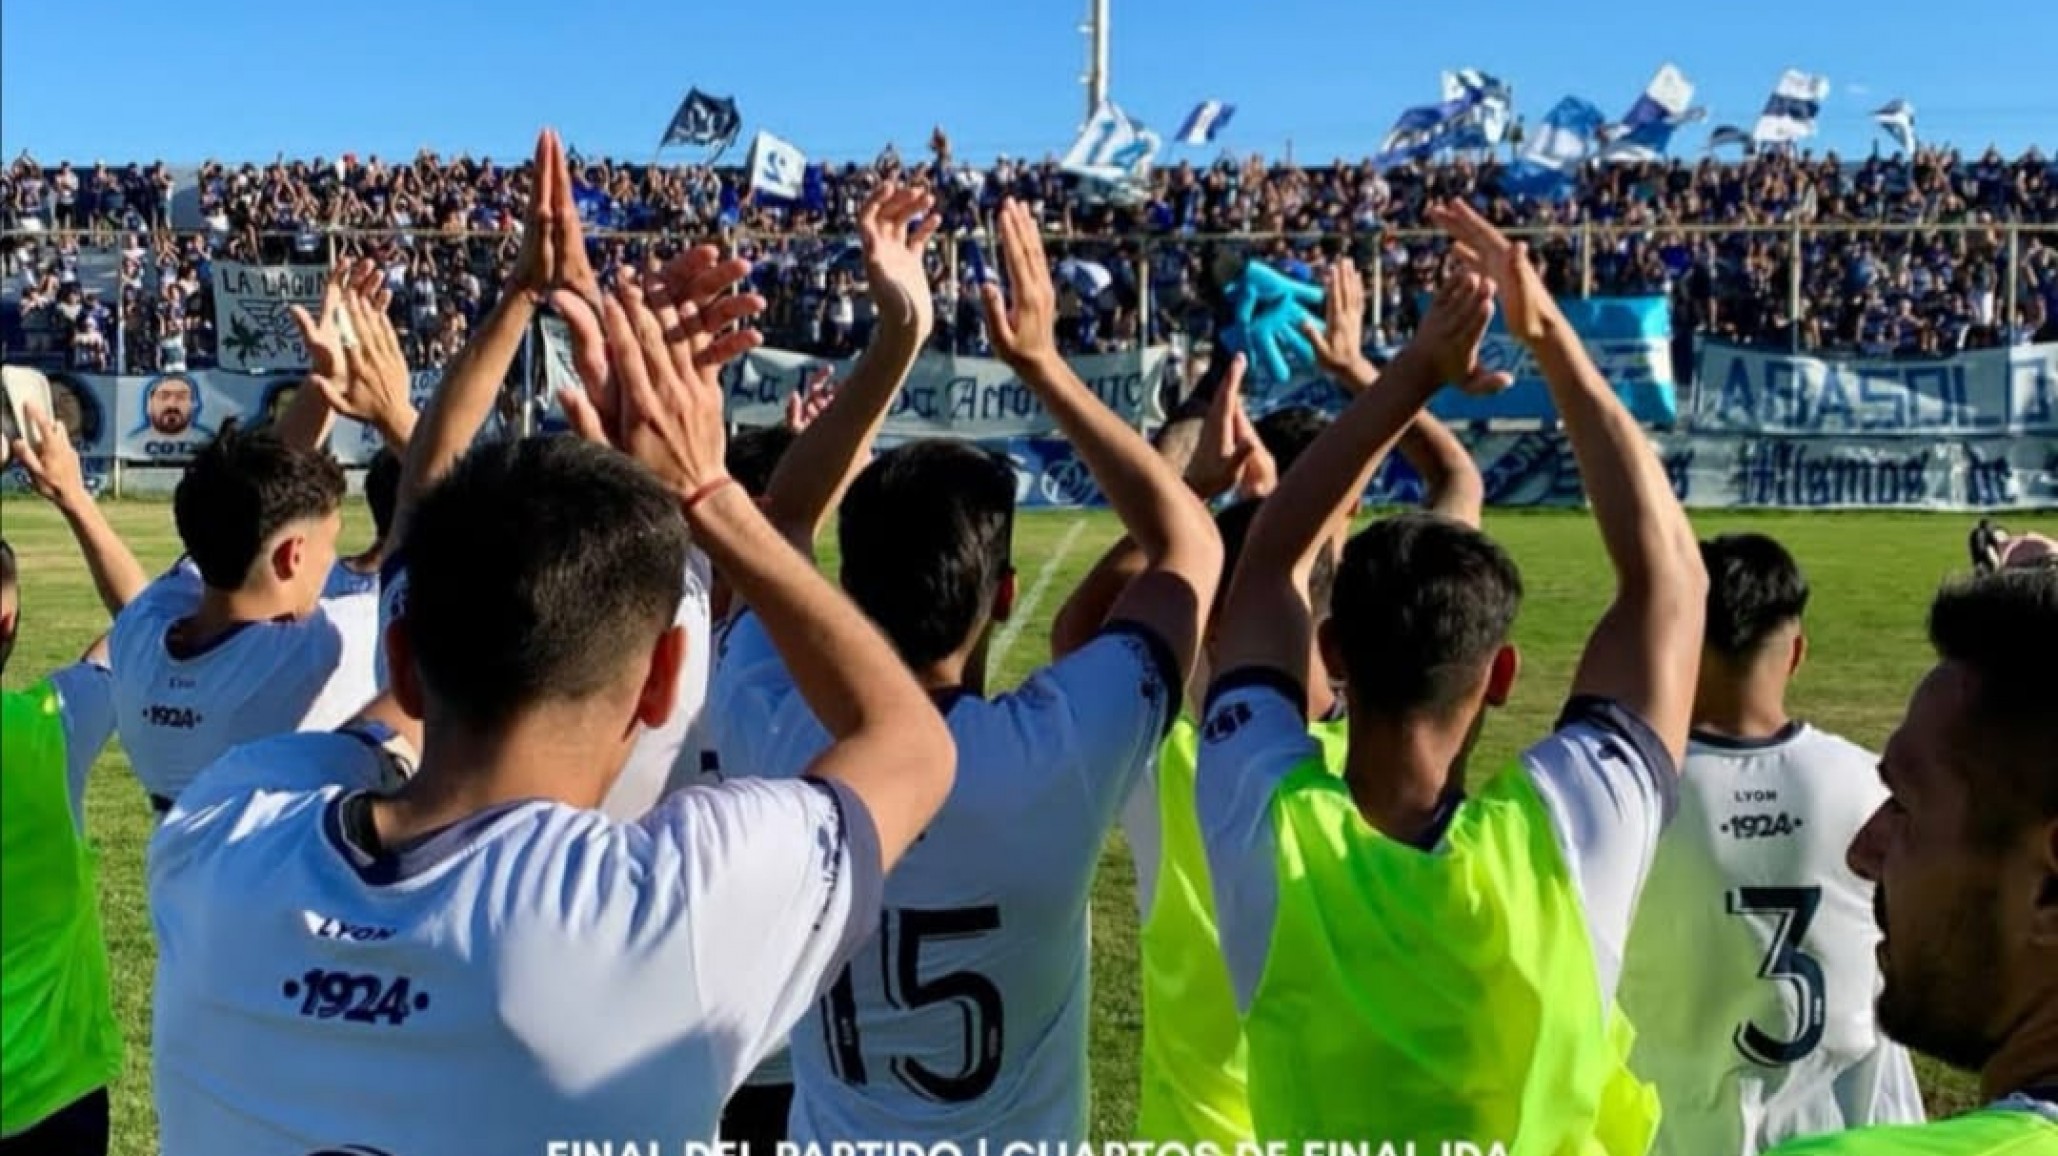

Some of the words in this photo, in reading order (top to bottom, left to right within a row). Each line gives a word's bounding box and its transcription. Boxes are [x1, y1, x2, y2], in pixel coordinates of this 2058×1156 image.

[222, 268, 252, 294] LA
[261, 272, 324, 297] LAGUN
[1735, 791, 1777, 801] LYON
[820, 905, 1004, 1104] 15
[1725, 886, 1825, 1067] 3
